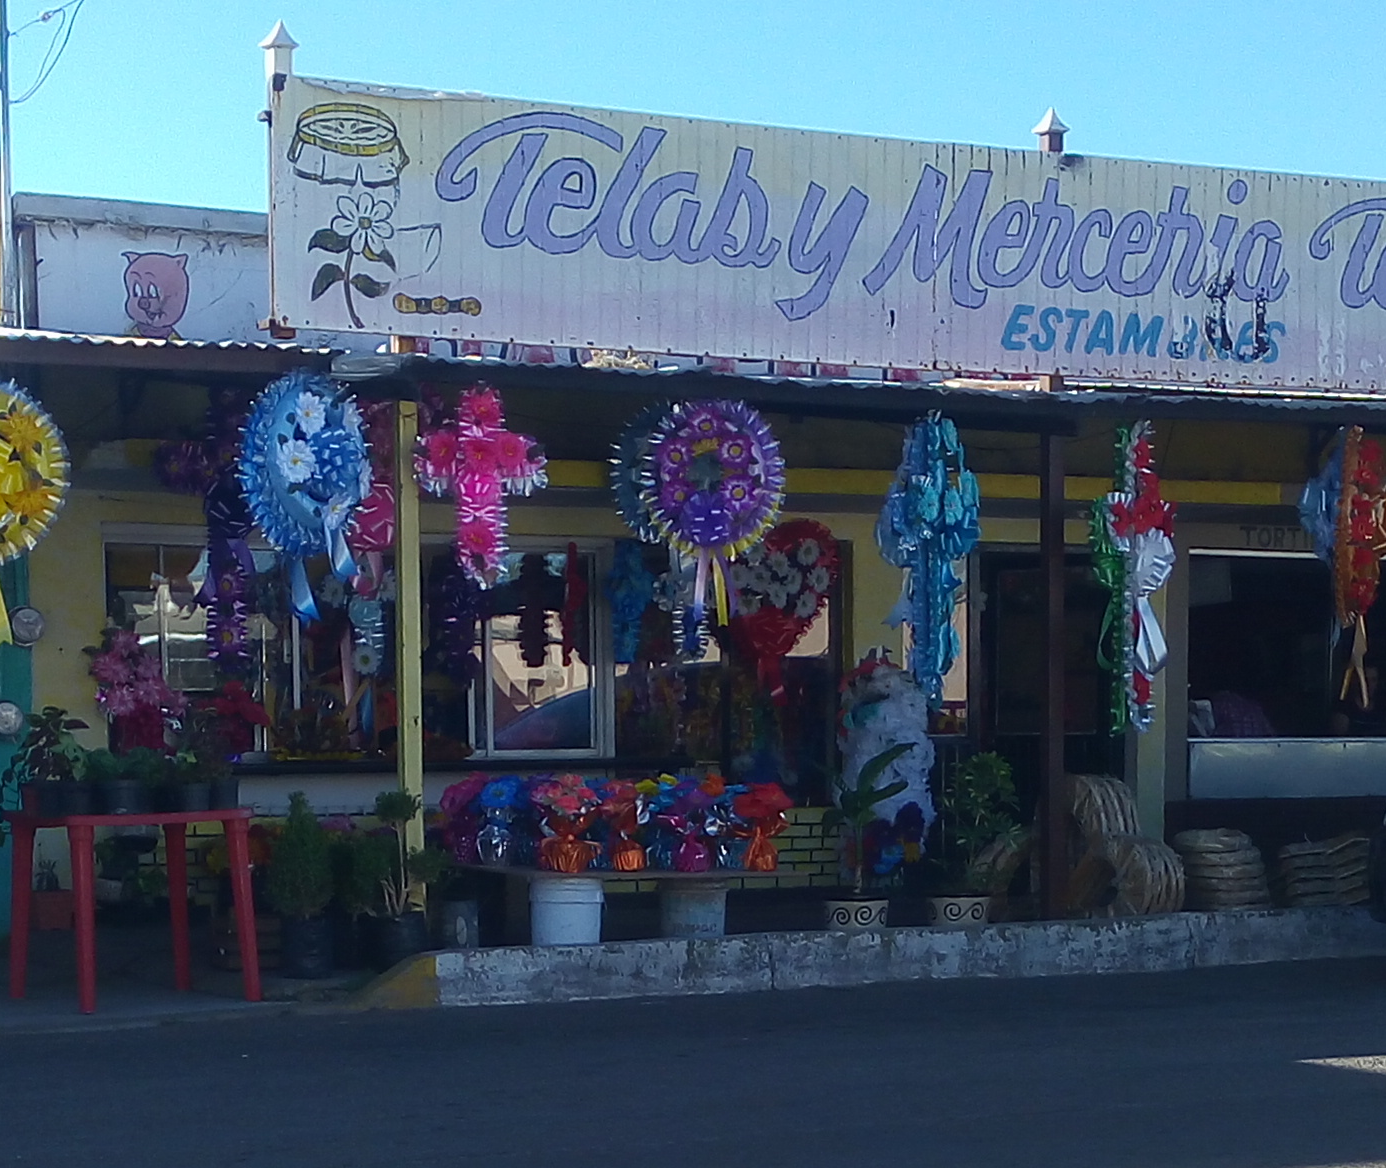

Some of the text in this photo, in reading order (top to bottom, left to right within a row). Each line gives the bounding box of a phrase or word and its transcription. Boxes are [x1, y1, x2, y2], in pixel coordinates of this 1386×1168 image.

[435, 111, 781, 269] Telas
[775, 181, 869, 321] y
[862, 163, 1290, 309] Merceria
